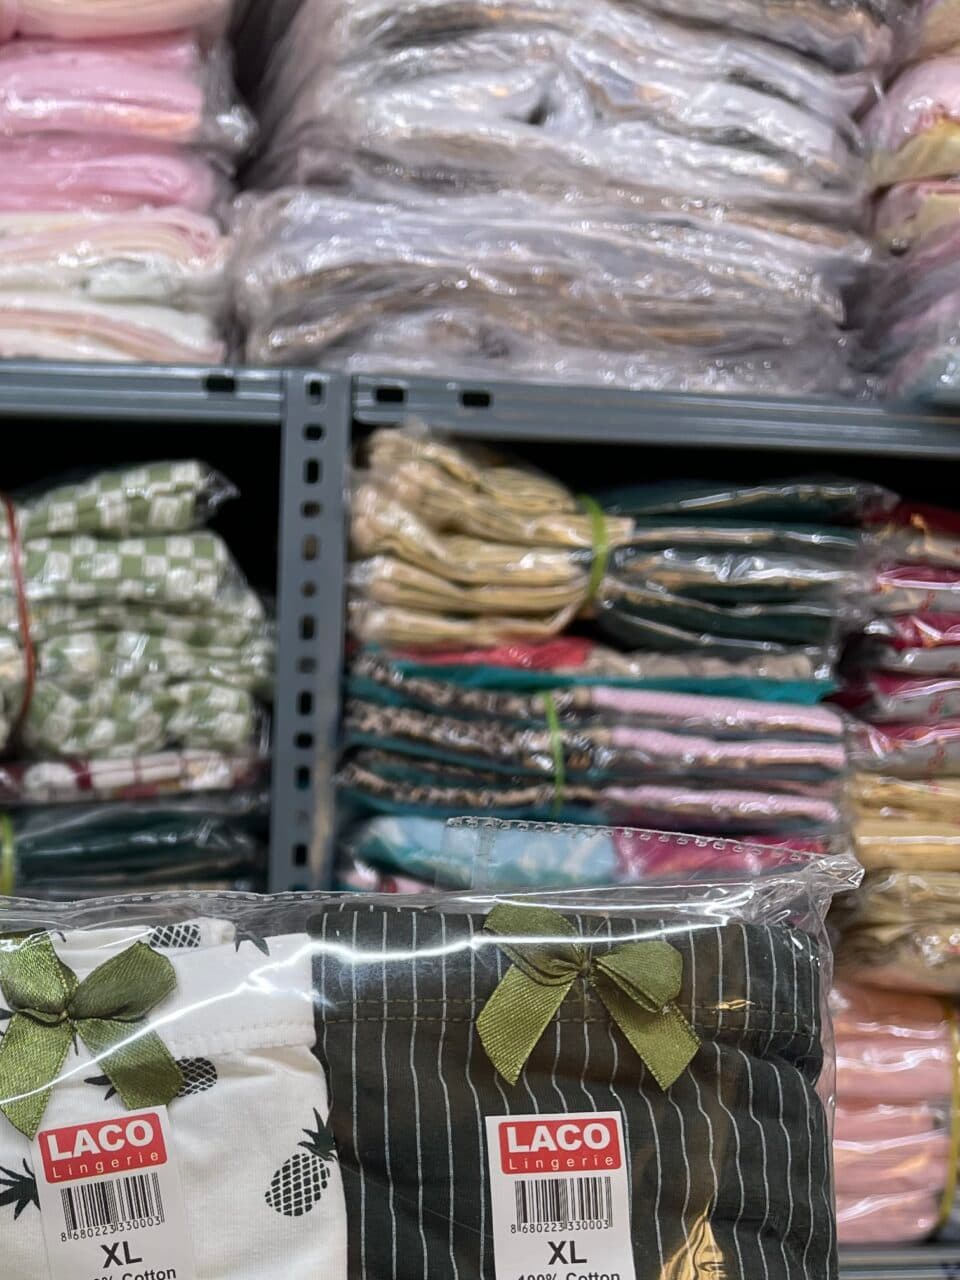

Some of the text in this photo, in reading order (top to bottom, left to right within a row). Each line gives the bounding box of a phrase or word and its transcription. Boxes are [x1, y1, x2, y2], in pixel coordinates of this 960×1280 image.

[47, 1119, 154, 1161] LACO
[506, 1123, 611, 1153] LACO
[52, 1151, 159, 1179] Lingerie
[509, 1155, 614, 1171] Lingerie
[100, 1240, 143, 1269] XL
[547, 1240, 587, 1265] XL
